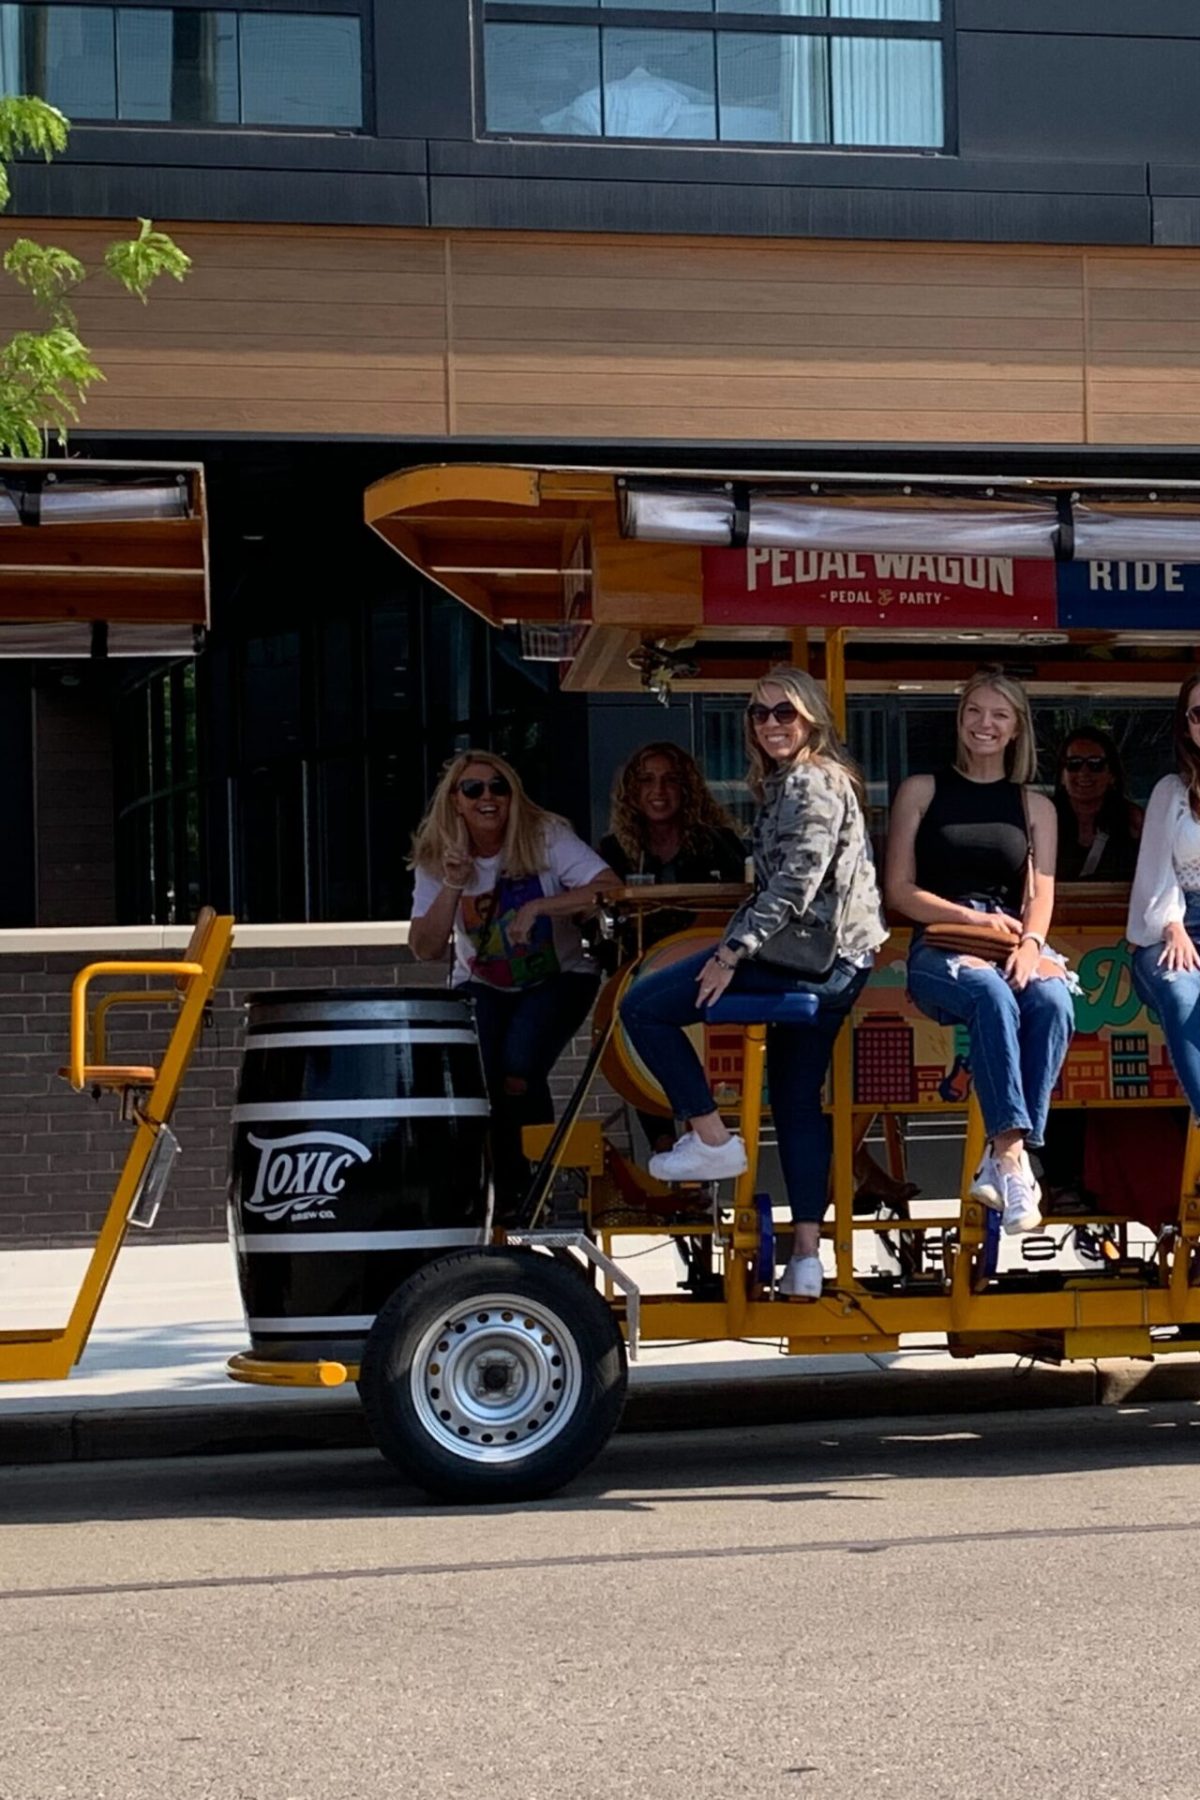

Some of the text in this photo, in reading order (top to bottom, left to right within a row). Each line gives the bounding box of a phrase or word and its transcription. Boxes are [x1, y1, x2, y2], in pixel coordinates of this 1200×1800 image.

[747, 548, 1014, 596] PEDAL WAGON
[1089, 560, 1185, 592] RIDE
[829, 590, 873, 604] PEDAL
[899, 592, 942, 605] PARTY
[247, 1131, 372, 1203] TOXIC
